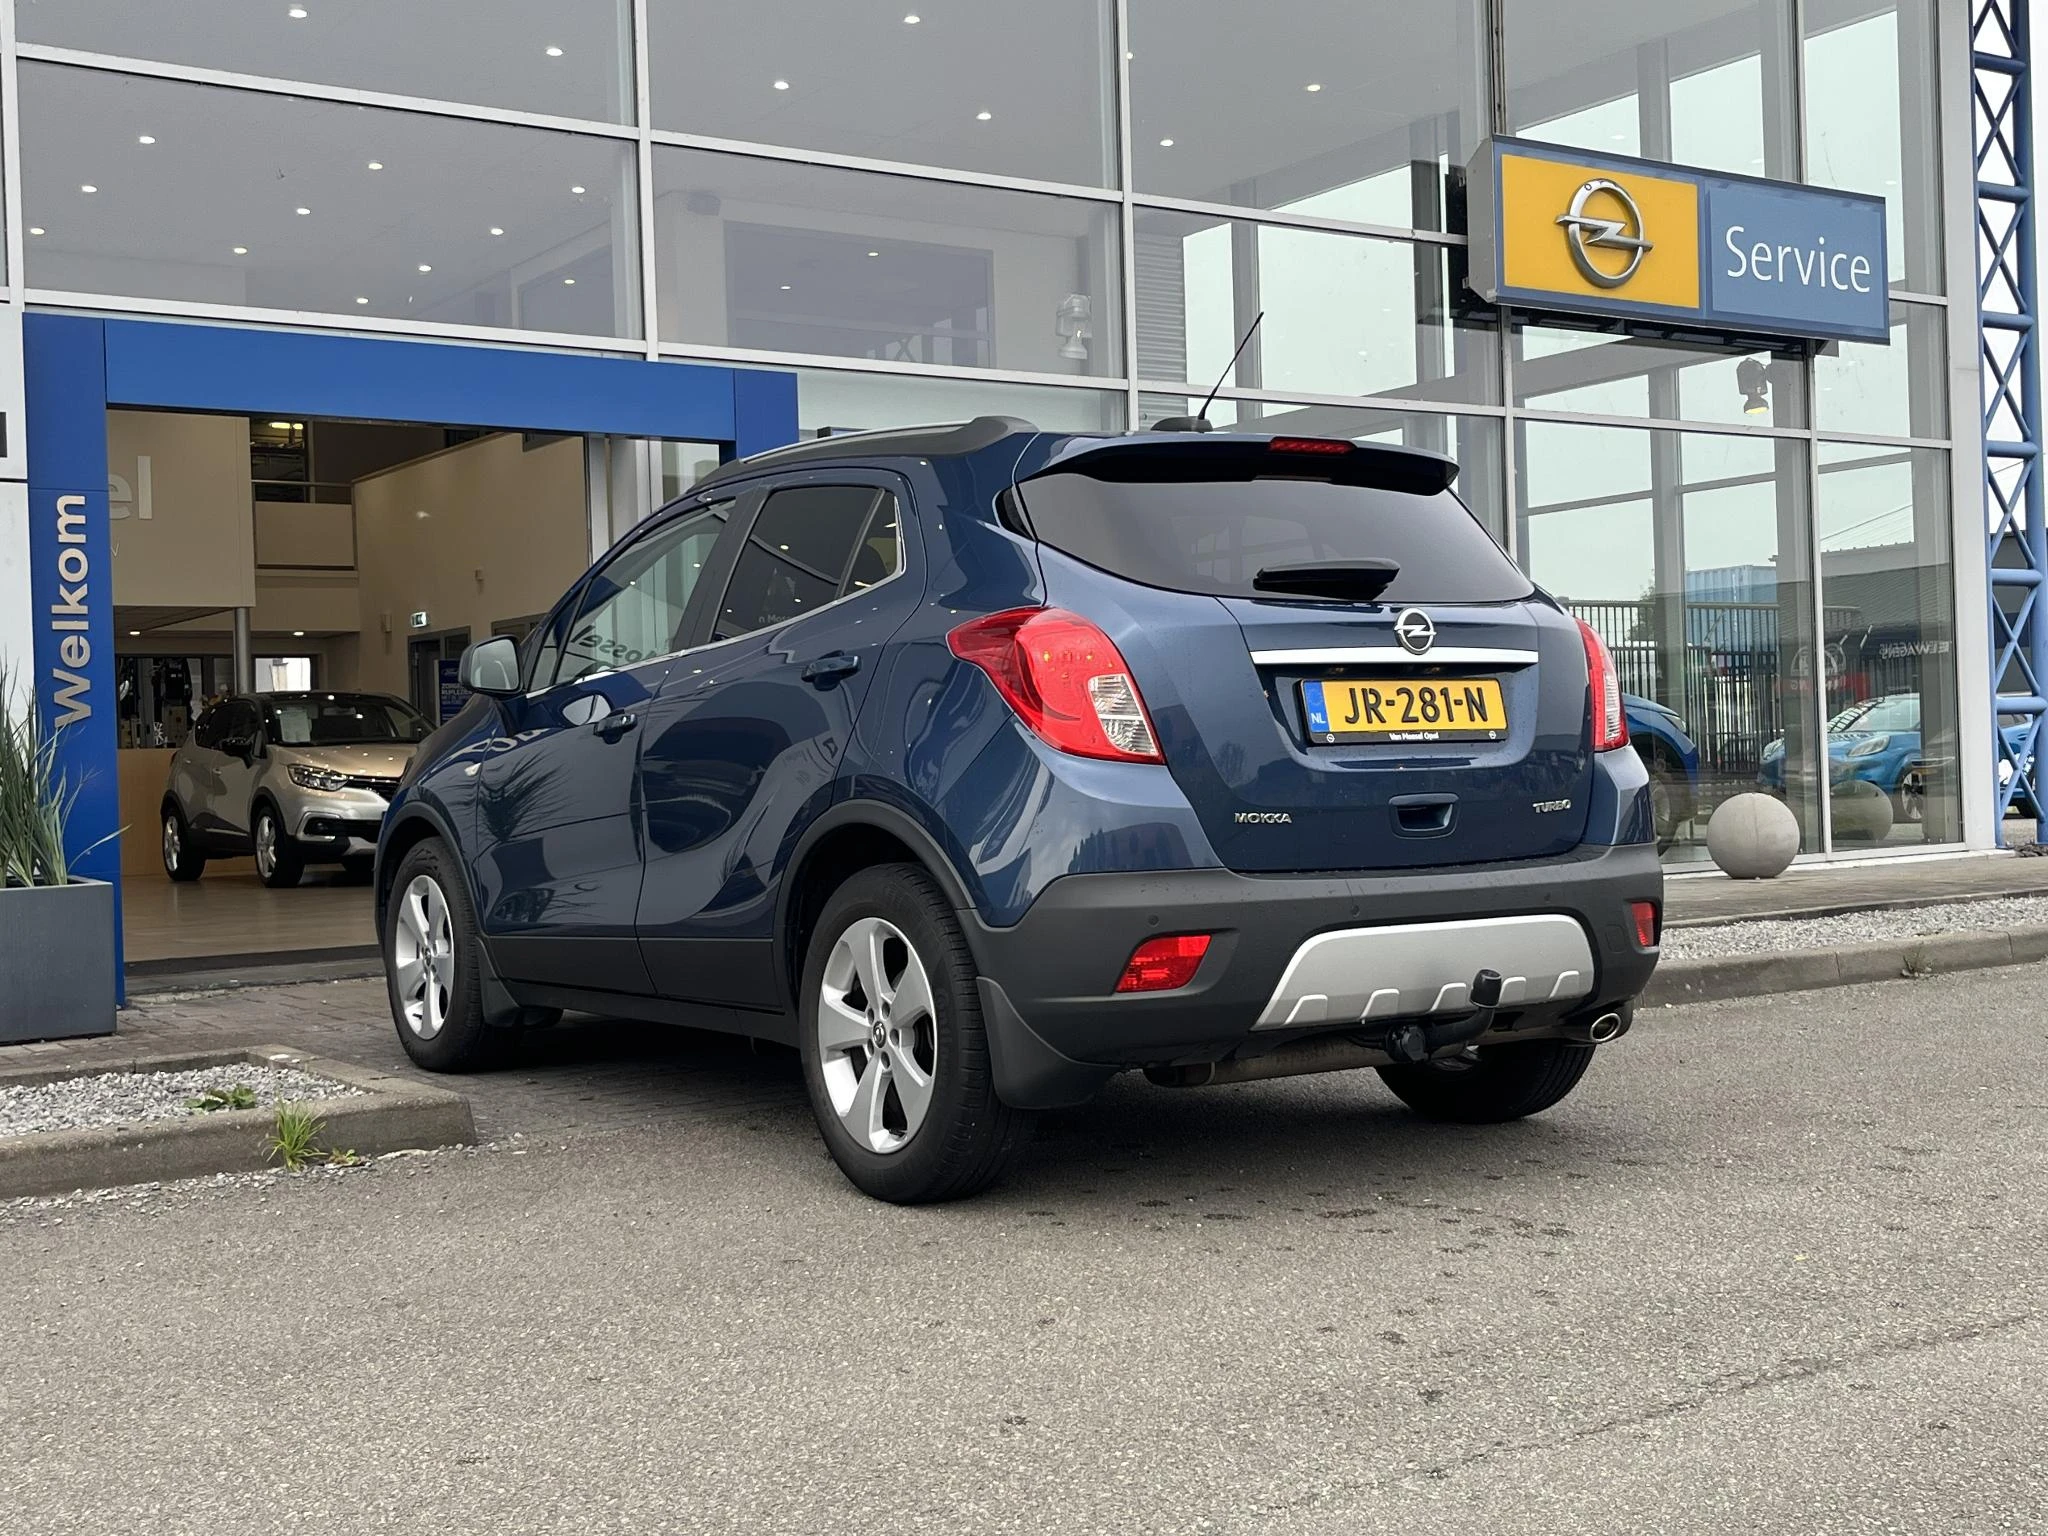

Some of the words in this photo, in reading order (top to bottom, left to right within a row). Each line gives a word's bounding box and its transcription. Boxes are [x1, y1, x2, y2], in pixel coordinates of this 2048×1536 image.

[1725, 225, 1871, 293] Service
[51, 494, 93, 729] Welkom
[1311, 712, 1327, 724] NL
[1344, 686, 1489, 725] JR-281-N
[1423, 731, 1439, 740] Opel
[1234, 812, 1292, 824] MOKKA
[1532, 799, 1571, 813] TURBO
